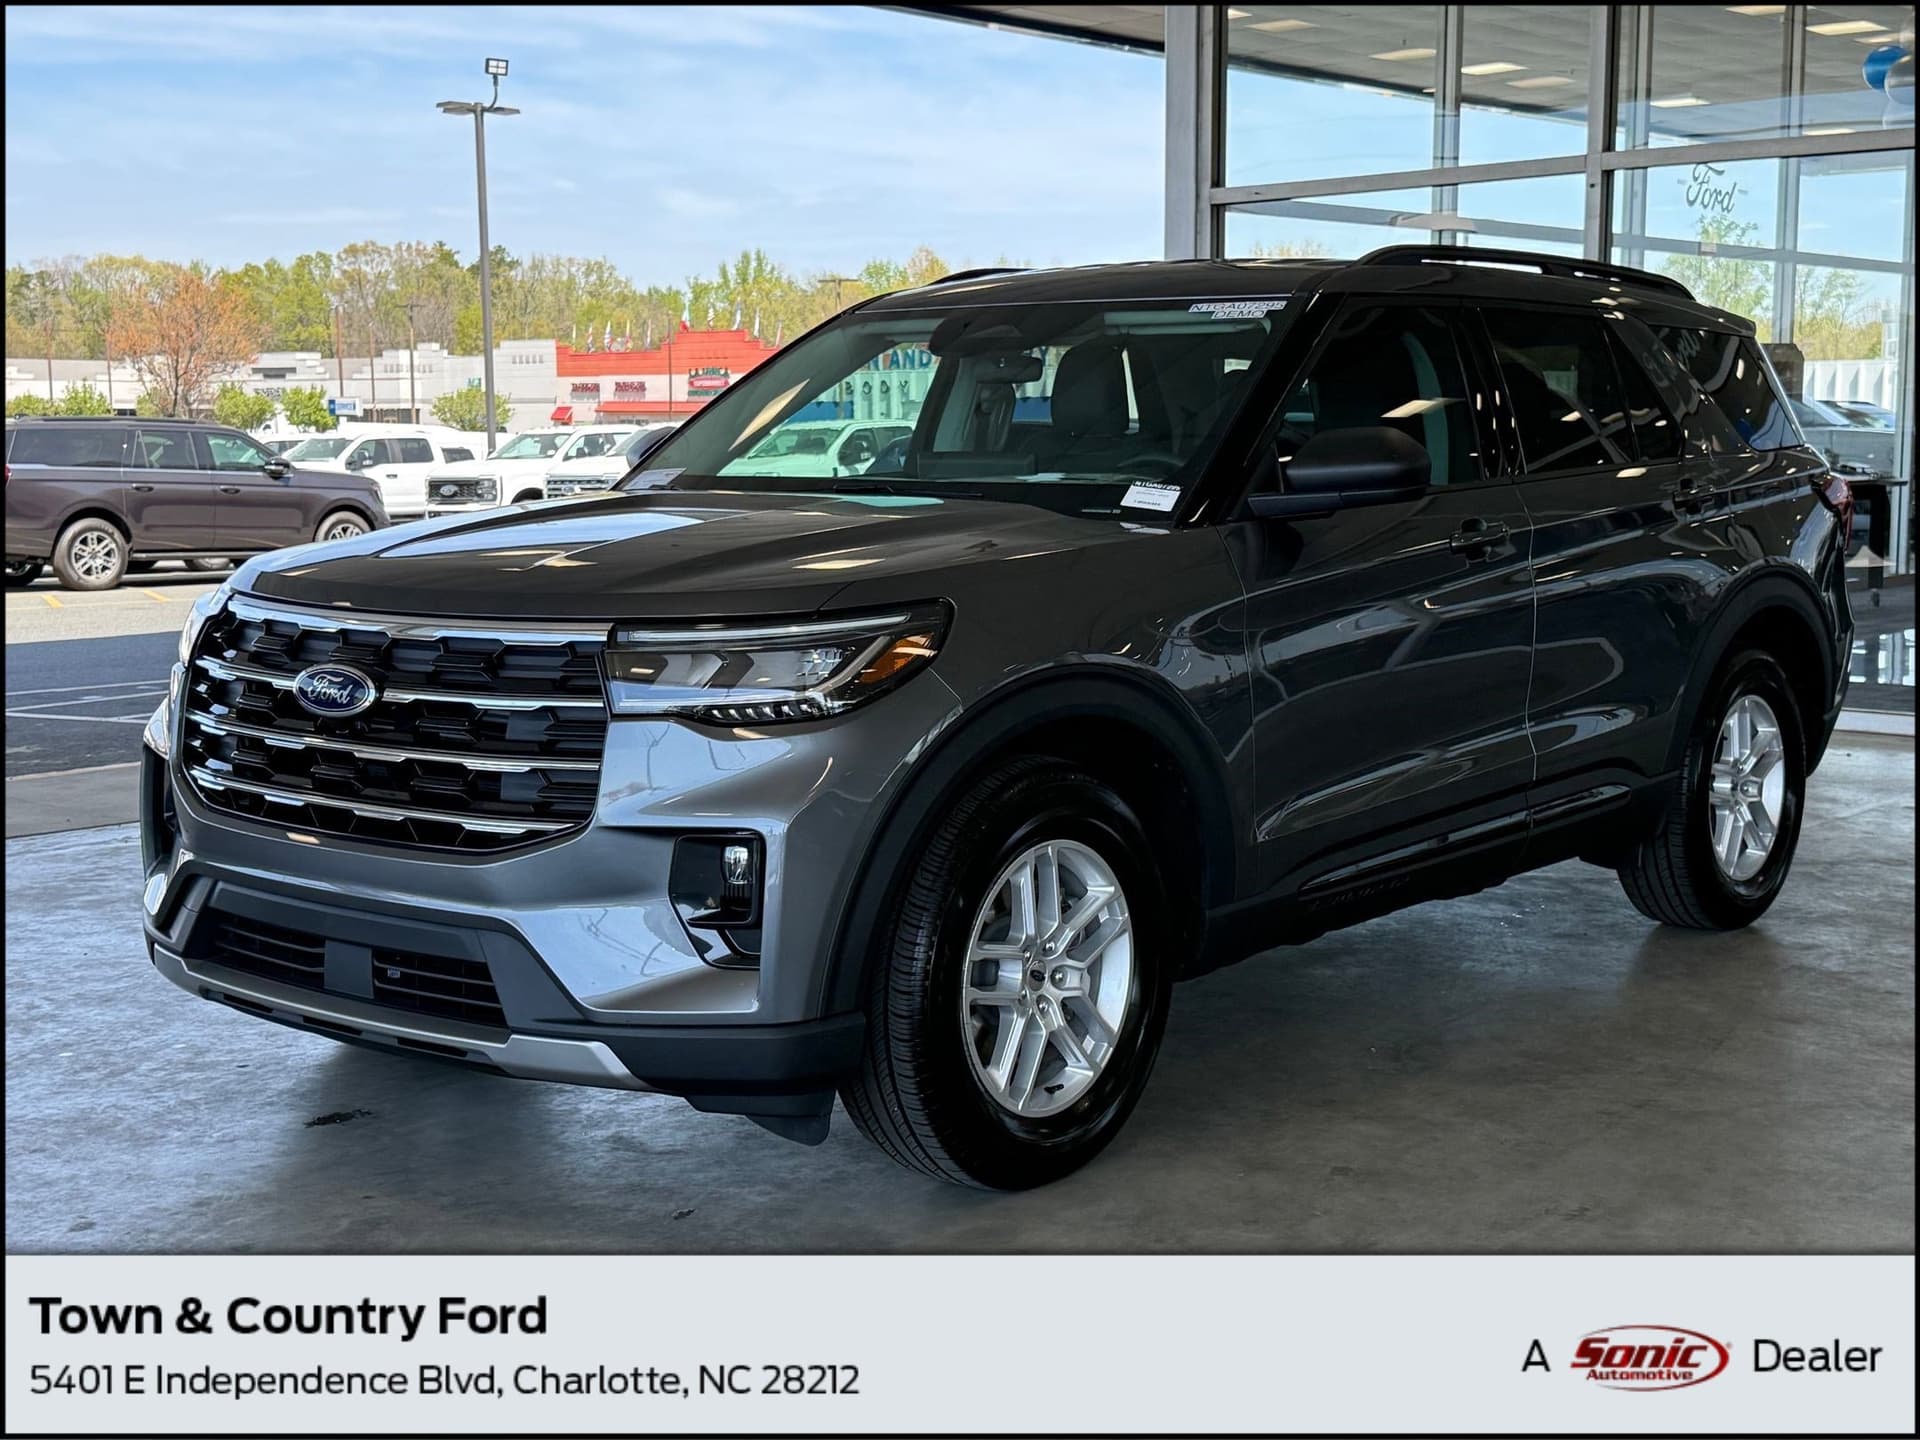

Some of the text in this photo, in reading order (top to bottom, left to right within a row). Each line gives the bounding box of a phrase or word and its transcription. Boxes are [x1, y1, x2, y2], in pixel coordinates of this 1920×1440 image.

[1686, 162, 1737, 214] Ford
[1214, 310, 1265, 319] DEMO
[307, 674, 353, 704] Ford
